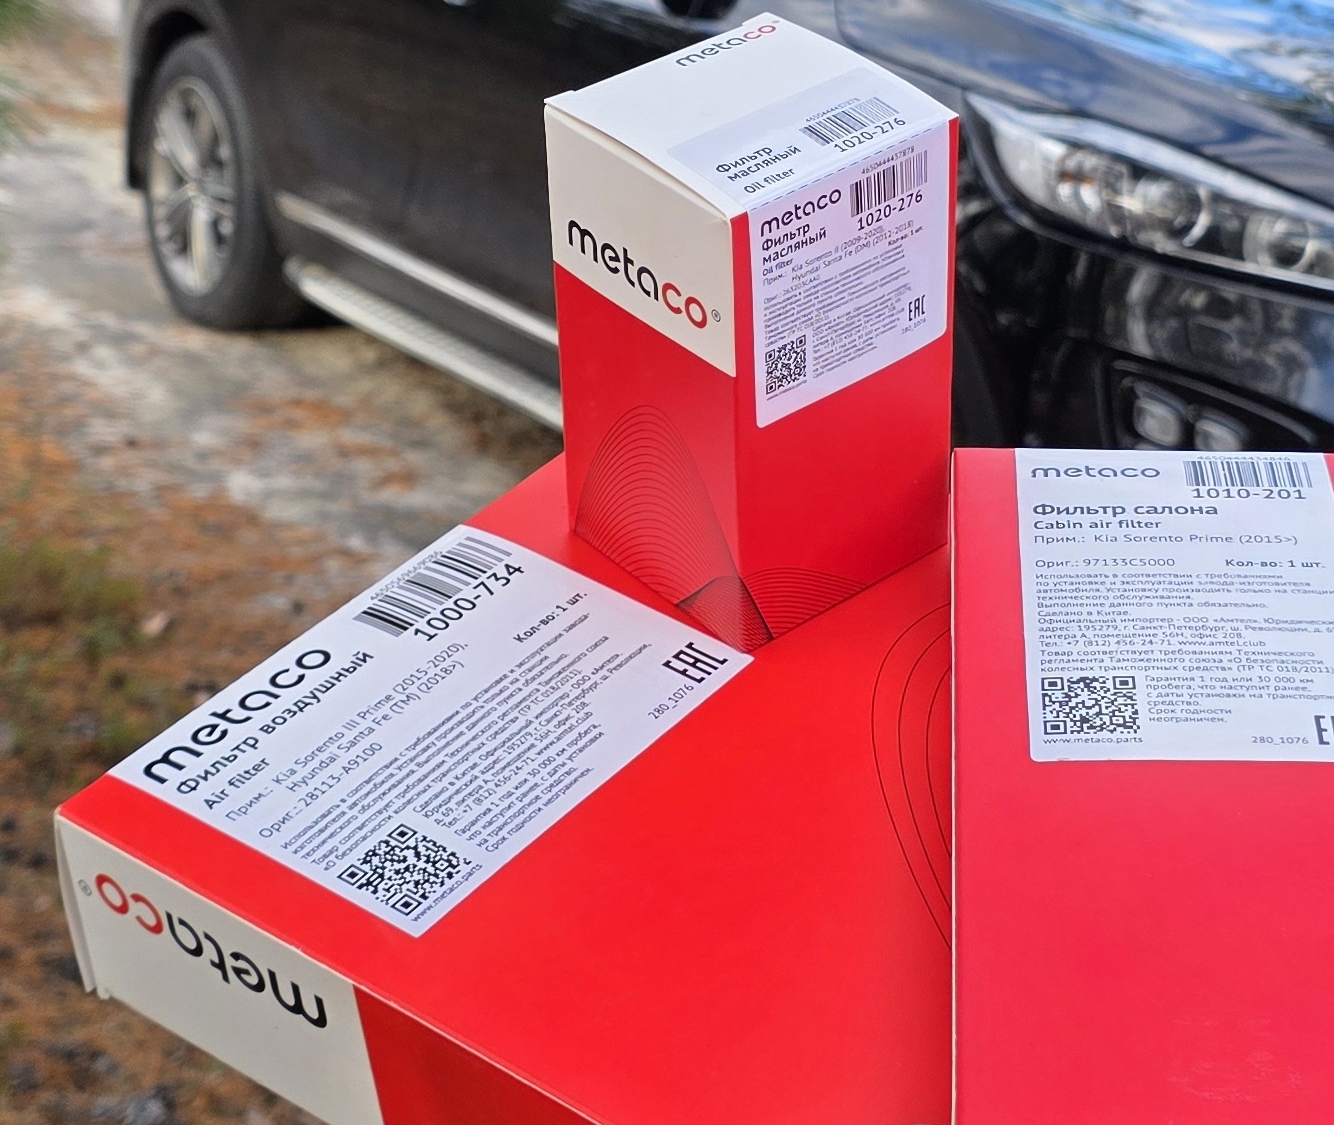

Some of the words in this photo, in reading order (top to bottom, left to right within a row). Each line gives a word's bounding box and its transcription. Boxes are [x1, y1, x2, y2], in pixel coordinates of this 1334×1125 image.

[675, 24, 777, 67] metaco
[834, 117, 906, 153] 1020-276
[715, 147, 773, 173] Фильтр
[727, 145, 801, 182] масляный
[743, 181, 766, 193] Oil
[763, 168, 795, 185] filter
[761, 189, 841, 237] metaco
[857, 189, 923, 231] 1020-276
[762, 223, 810, 251] Фильтр
[763, 227, 826, 266] масляный
[567, 219, 708, 330] metaco
[762, 265, 774, 277] Oil
[775, 258, 793, 271] filter
[1031, 465, 1161, 478] metaco
[1033, 503, 1126, 517] Фильтр
[1133, 506, 1218, 515] салона
[1191, 488, 1307, 500] 1010-201
[1033, 520, 1083, 530] Cabin
[1089, 520, 1112, 529] air
[1117, 520, 1161, 529] filter
[1034, 535, 1085, 545] Прим.:
[1094, 534, 1117, 543] Kia
[1123, 534, 1183, 543] Sorento
[1189, 534, 1233, 543] Prime
[1239, 535, 1298, 545] (2015>)
[1035, 559, 1078, 569] Ориг.:
[1082, 558, 1175, 567] 97133C5000
[1225, 559, 1283, 567] Кол-во:
[1287, 560, 1296, 568] 1
[414, 563, 524, 642] 1000-734
[513, 611, 560, 643] Кол-во:
[566, 593, 587, 606] шт.
[143, 649, 331, 785] metaco
[271, 768, 297, 785] Kia
[294, 731, 345, 768] Sorento
[342, 719, 360, 731] III
[356, 694, 396, 720] Prime
[392, 643, 469, 695] (2015-2020),
[647, 684, 694, 719] 280_1076
[176, 736, 259, 794] Фильтр
[258, 651, 374, 735] воздушный
[285, 752, 340, 792] Hyundai
[337, 726, 376, 753] Santa
[371, 714, 392, 726] Fe
[389, 693, 421, 714] (TM)
[417, 660, 465, 694] (2018>)
[1251, 736, 1309, 745] 280_1076
[203, 788, 229, 810] Air
[227, 757, 270, 789] filter
[297, 742, 383, 807] 28113-A9100
[95, 873, 328, 1029] metaco
